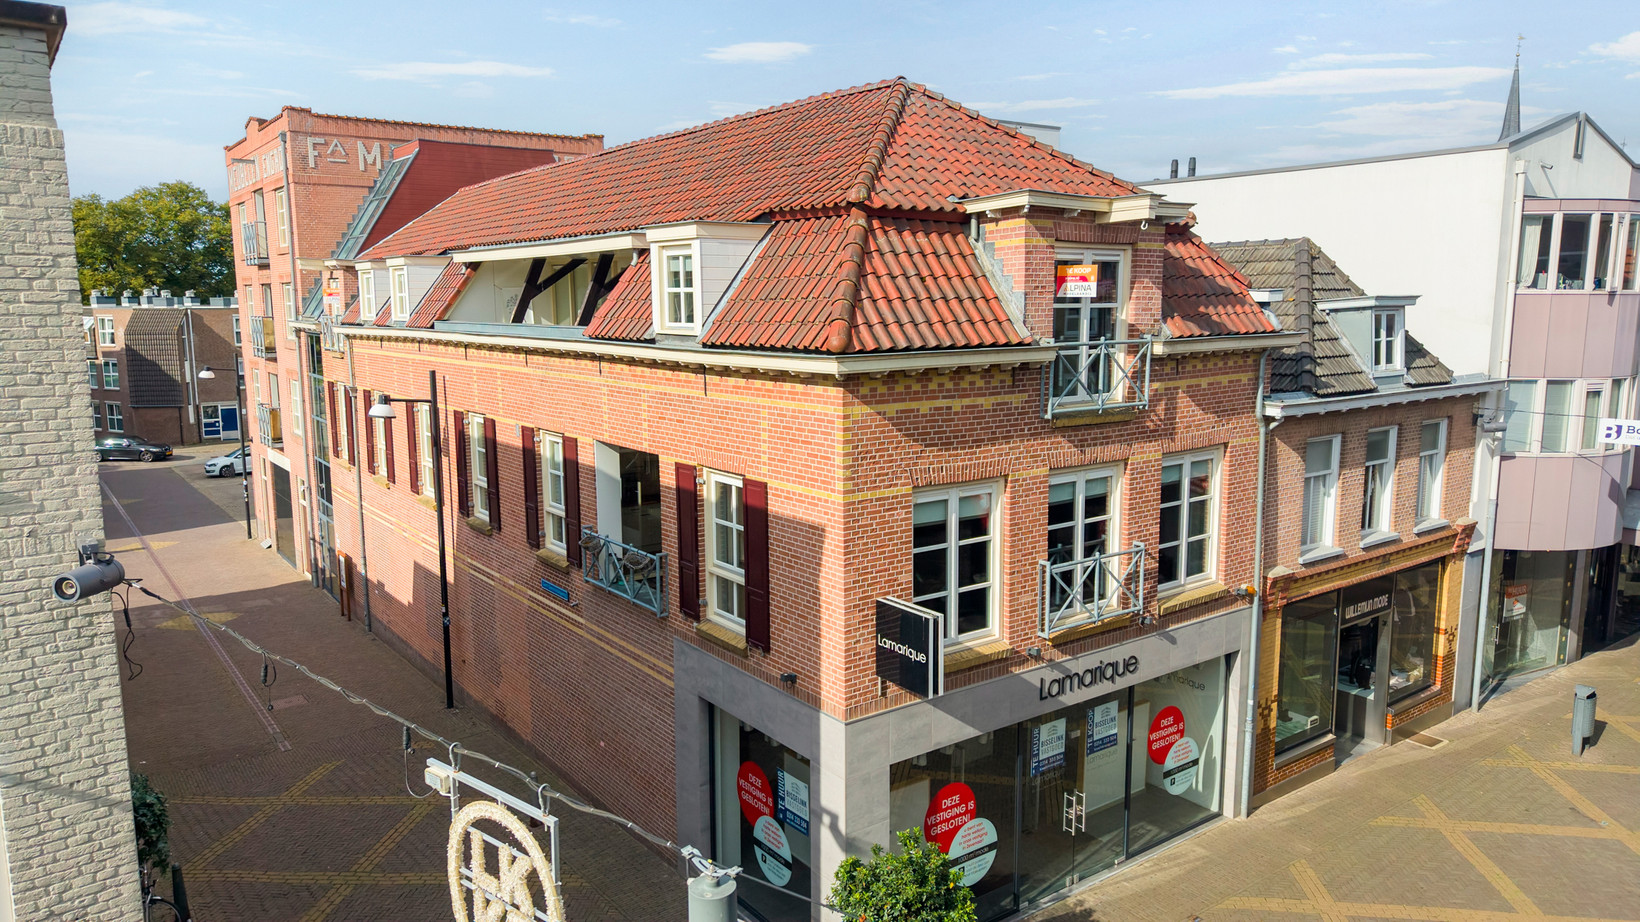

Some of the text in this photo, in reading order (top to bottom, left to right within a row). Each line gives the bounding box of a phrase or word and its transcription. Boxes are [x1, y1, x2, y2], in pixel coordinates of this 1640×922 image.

[1063, 284, 1092, 292] ALPINA
[877, 633, 927, 664] Lamarique
[1039, 655, 1139, 701] Lamarique
[1095, 716, 1117, 728] BISSELINK
[1160, 716, 1174, 728] DEZE
[1149, 722, 1184, 741] VESTIGING IS
[1032, 728, 1040, 769] TE HUUR
[1041, 735, 1064, 748] BISSELINK
[1041, 742, 1064, 756] VASTGOED
[1152, 733, 1181, 750] GESLOTEN!
[748, 772, 762, 788] DEZE
[738, 776, 773, 807] VESTIGING IS
[786, 789, 808, 808] BISSELINK
[741, 790, 770, 816] GESLOTEN!
[778, 797, 785, 810] TE
[942, 794, 960, 809] DEZE
[927, 800, 974, 826] VESTIGING IS
[930, 813, 971, 836] GESLOTEN!
